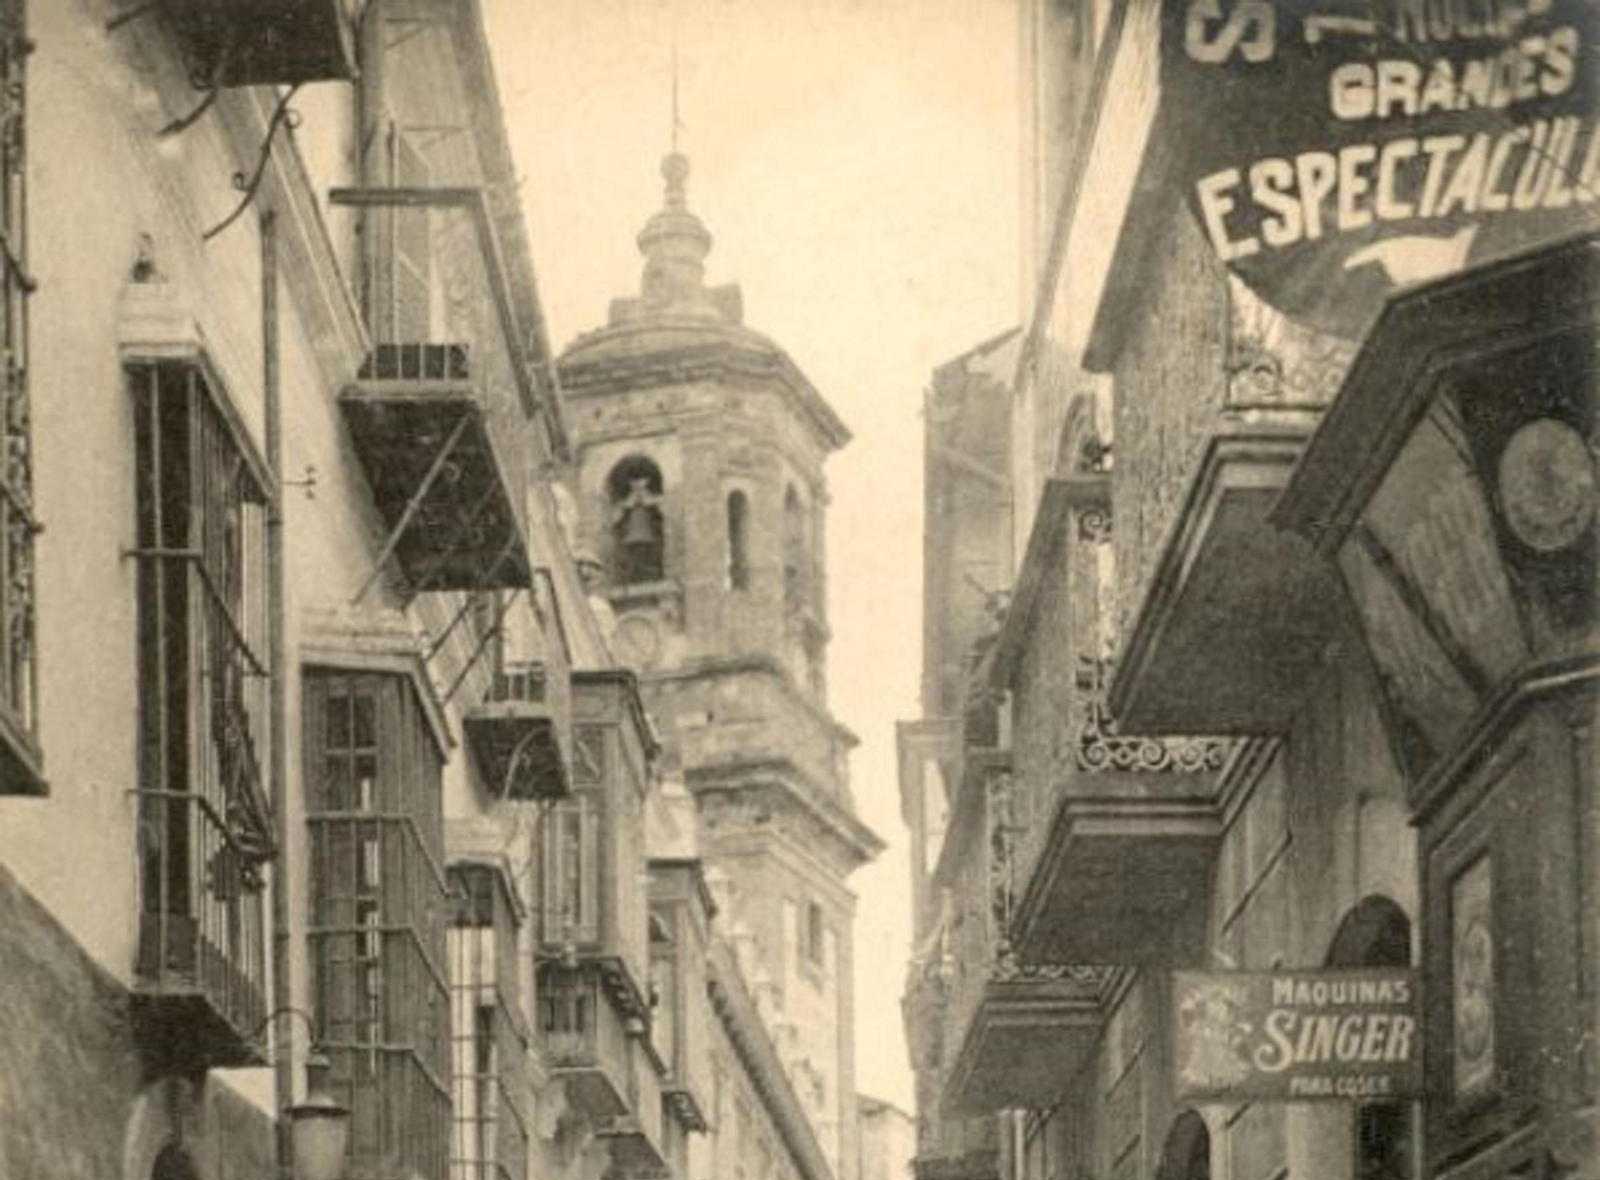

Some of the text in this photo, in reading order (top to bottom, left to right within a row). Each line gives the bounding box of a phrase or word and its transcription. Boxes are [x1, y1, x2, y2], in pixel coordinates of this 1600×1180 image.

[1330, 26, 1579, 118] GRANDES
[1272, 976, 1411, 1006] MAQUINAS
[1253, 1008, 1415, 1072] SINGER
